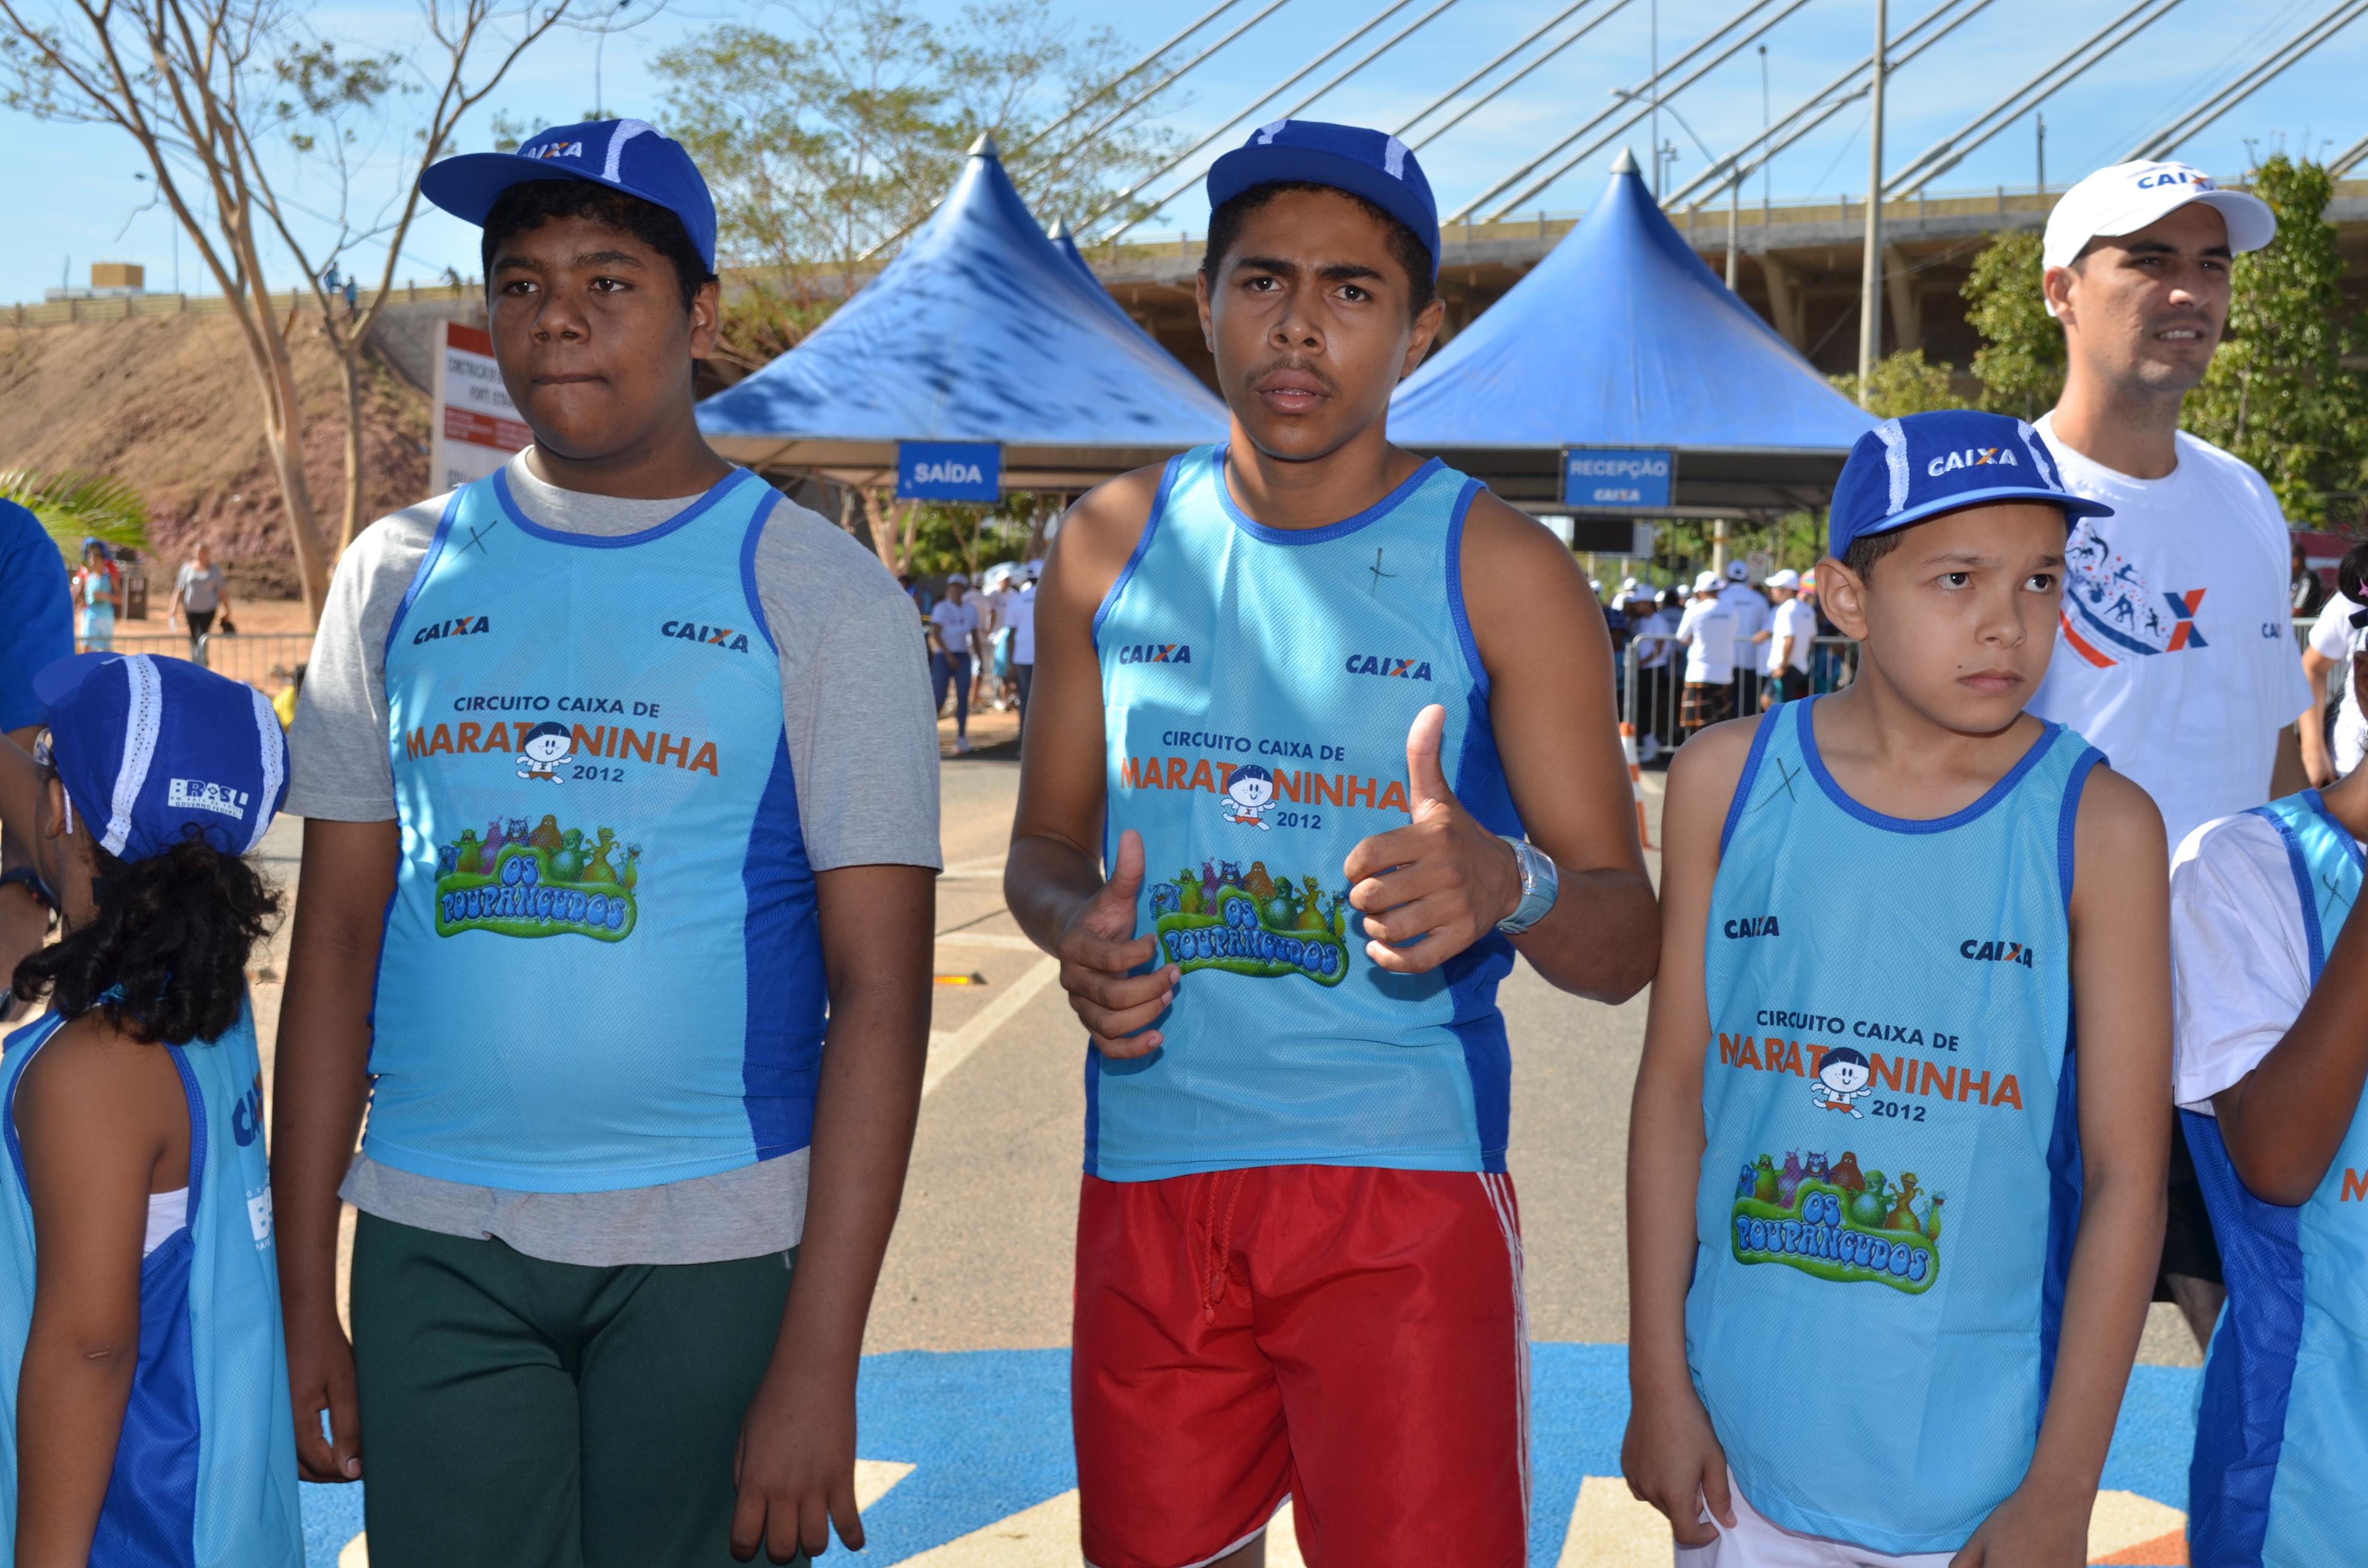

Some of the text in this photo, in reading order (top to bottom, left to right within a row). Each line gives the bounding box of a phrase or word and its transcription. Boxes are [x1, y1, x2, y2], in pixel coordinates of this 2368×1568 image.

[523, 142, 582, 159] AIXA
[2137, 172, 2213, 190] CAIX
[914, 459, 983, 484] SAÍDA
[1570, 458, 1669, 480] RECEPÇÃO
[1927, 447, 2019, 477] CAIXA
[1593, 488, 1641, 501] CAIXA
[413, 616, 490, 645] CAIXA
[661, 620, 749, 654] CAIXA
[1119, 644, 1191, 665] CAIXA
[1345, 654, 1433, 682] CAIXA
[453, 696, 660, 718] CIRCUITO CAIXA DE
[1162, 731, 1344, 761] CIRCUITO CAIXA DE
[571, 765, 624, 782] 2012
[213, 806, 238, 816] FEDERA
[1277, 811, 1322, 829] 2012
[502, 855, 539, 887] OS
[442, 884, 626, 930] POUPANÇUDOS
[1224, 897, 1258, 929] OS
[1164, 925, 1340, 975] POUPANÇUDOS
[1960, 940, 2033, 969] CAIXA
[1756, 1010, 1960, 1052] CIRCUITO CAIXA DE
[1871, 1100, 1926, 1122] 2012
[1803, 1191, 1842, 1228] OS
[1735, 1215, 1929, 1282] POUPANÇUDOS
